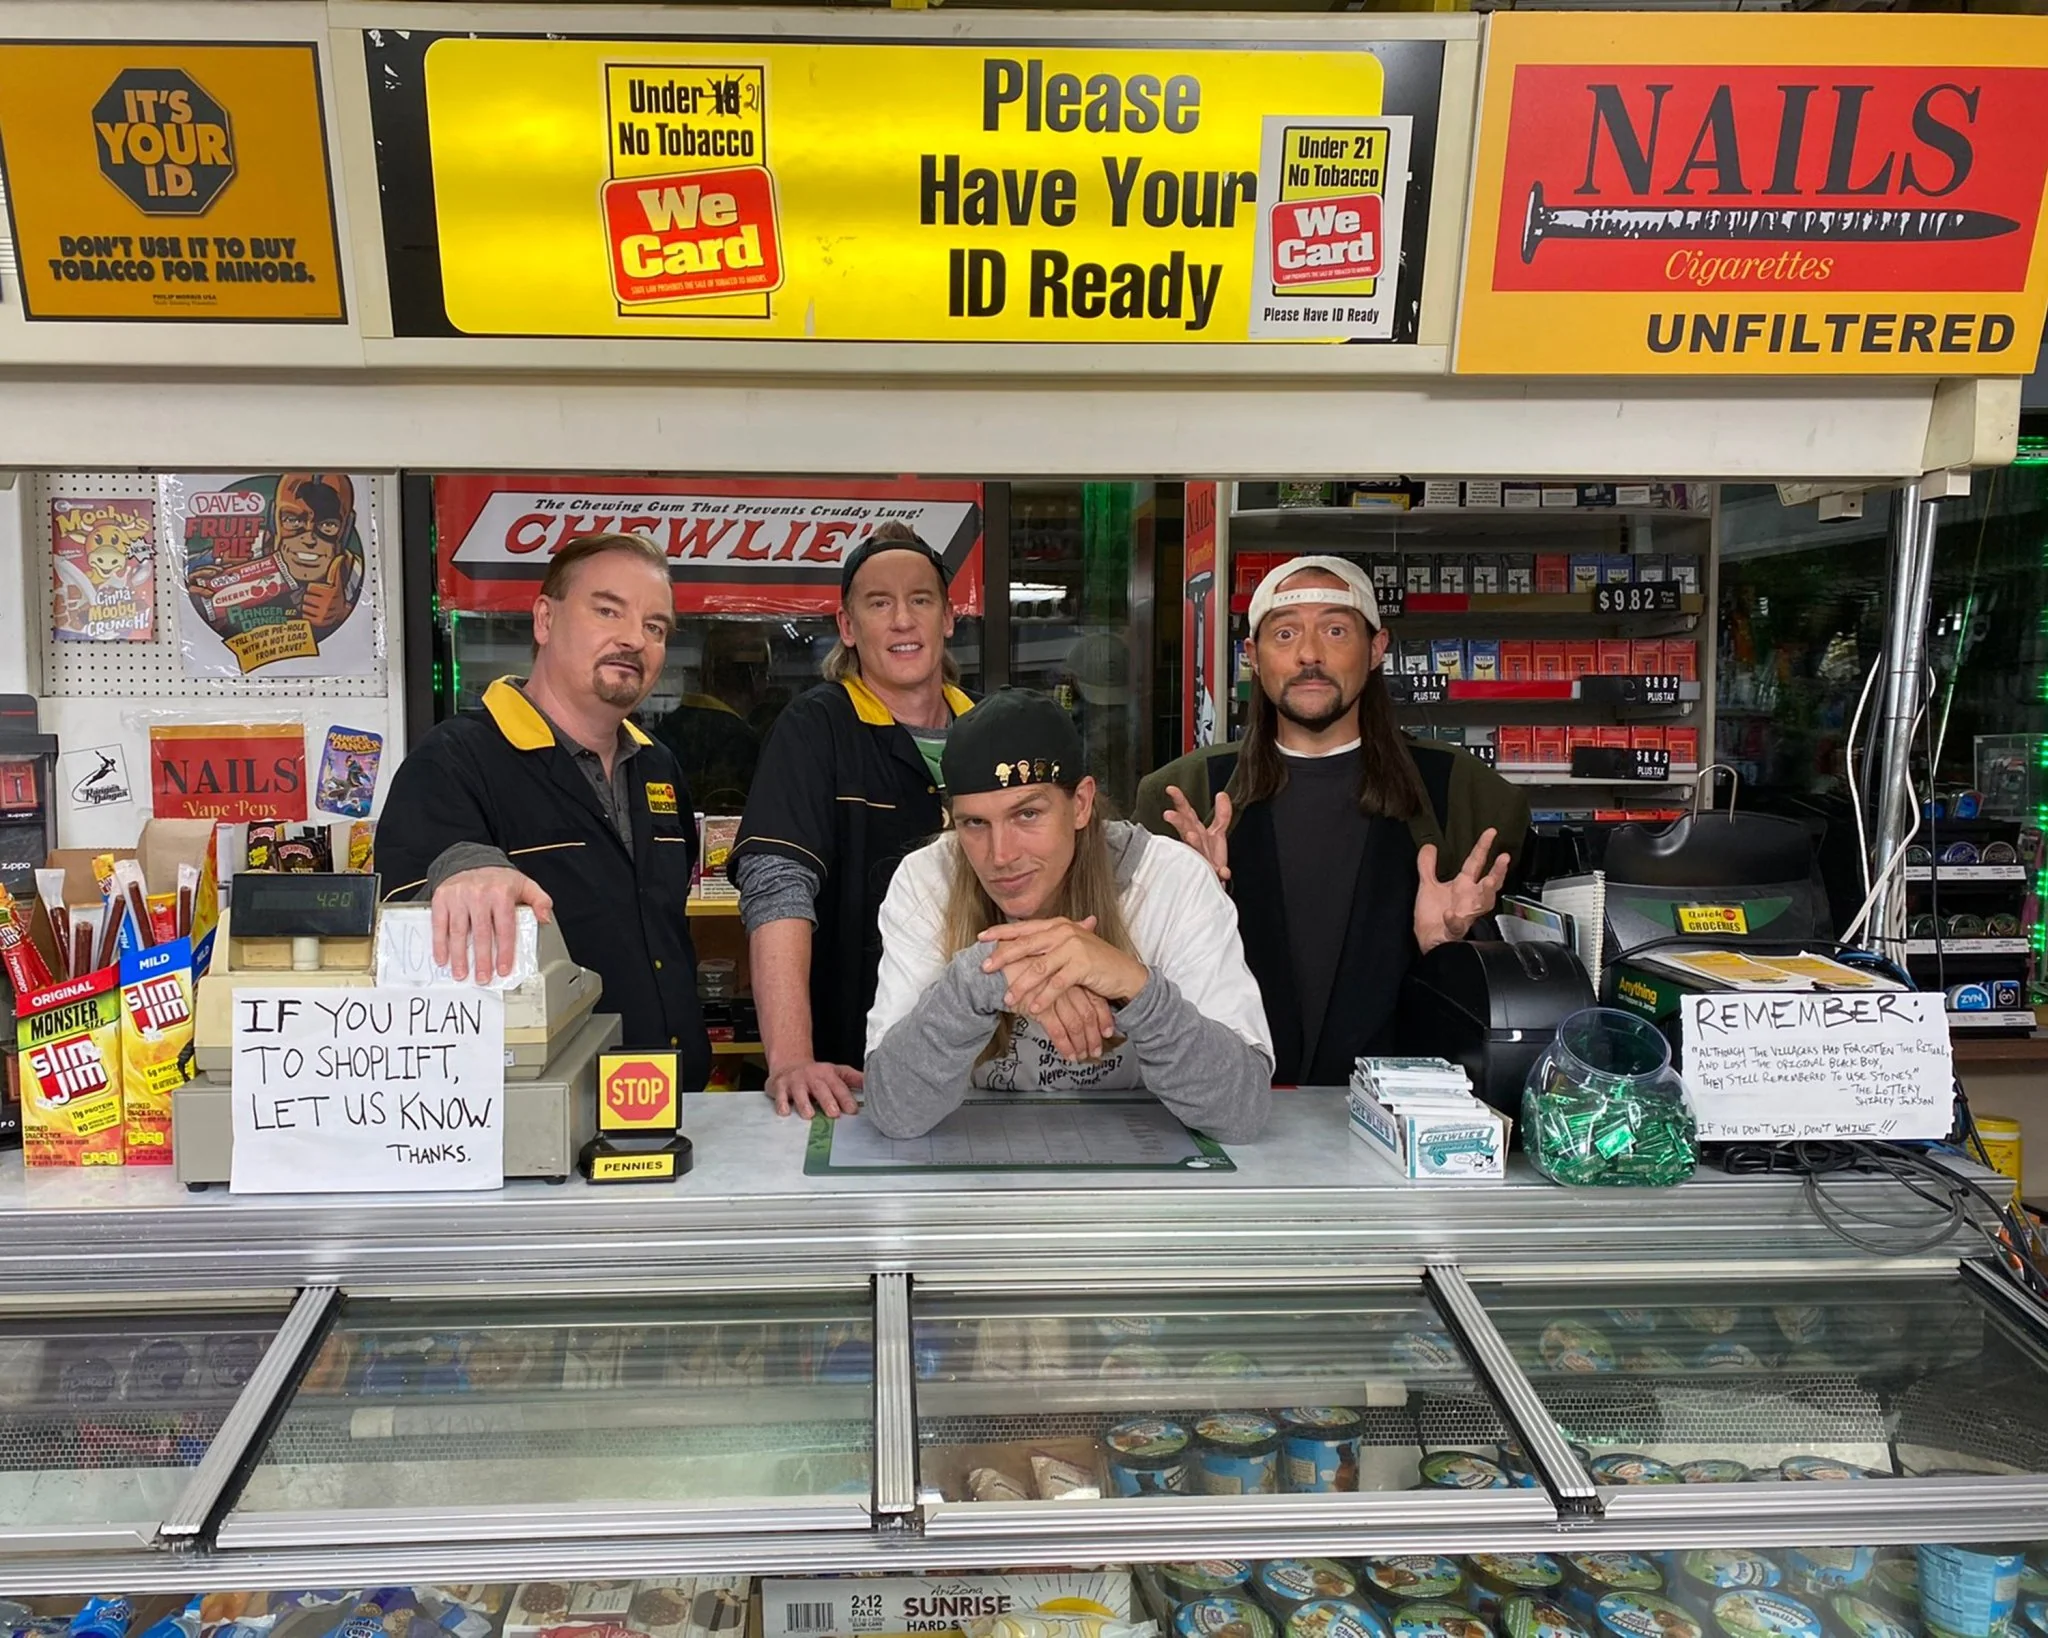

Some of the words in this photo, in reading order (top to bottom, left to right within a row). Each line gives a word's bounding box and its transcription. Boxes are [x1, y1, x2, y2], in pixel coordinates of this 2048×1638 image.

[124, 89, 193, 123] IT'S
[629, 79, 702, 114] Under
[983, 59, 1201, 132] Please
[95, 122, 232, 167] YOUR
[618, 122, 650, 156] No
[656, 123, 754, 157] Tobacco
[1299, 136, 1349, 159] Under
[1353, 137, 1374, 159] 21
[1574, 83, 1982, 197] NAILS
[145, 164, 197, 197] I.D.
[1288, 164, 1309, 186] No
[1314, 165, 1379, 187] Tobacco
[919, 154, 1077, 228] Have
[1101, 156, 1257, 229] Your
[637, 185, 738, 232] We
[1294, 205, 1361, 238] We
[59, 236, 133, 258] DON'T
[139, 237, 182, 258] USE
[188, 237, 209, 258] IT
[213, 237, 245, 258] TO
[250, 238, 296, 259] BUY
[620, 224, 764, 279] Card
[1278, 232, 1375, 270] Card
[49, 259, 155, 281] TOBACCO
[162, 260, 209, 282] FOR
[215, 262, 316, 283] MINORS.
[1665, 248, 1834, 287] Cigarettes
[948, 249, 1006, 318] ID
[1029, 249, 1223, 331] Ready
[1264, 308, 1299, 322] Please
[1303, 308, 1333, 322] Have
[1332, 308, 1344, 322] ID
[1347, 308, 1380, 324] Ready
[1646, 313, 2016, 353] UNFILTERED
[535, 499, 565, 510] The
[570, 500, 643, 513] Chewing
[648, 501, 685, 512] Gum
[690, 503, 728, 513] That
[733, 504, 805, 515] Prevents
[811, 506, 871, 518] Cruddy
[875, 508, 924, 519] Lung!
[184, 517, 265, 539] FRUIT
[213, 536, 256, 558] PIE
[215, 589, 249, 605] CHERRY
[88, 602, 137, 621] Mooby
[88, 607, 151, 637] CRUNCH!
[228, 606, 283, 625] RANGER
[242, 643, 260, 655] WITH
[262, 640, 268, 648] A
[269, 636, 285, 647] HOT
[287, 632, 307, 643] LOAD
[250, 629, 269, 642] YOUR
[271, 623, 306, 636] PIE-HOLE
[255, 649, 277, 662] FROM
[1413, 692, 1428, 701] PLUS
[1429, 692, 1440, 700] TAX
[1647, 692, 1663, 701] PLUS
[1663, 692, 1675, 700] TAX
[332, 739, 382, 752] DANGER
[159, 757, 299, 797] NAILS
[1637, 766, 1652, 775] PLUS
[1654, 767, 1664, 776] TAX
[183, 800, 230, 819] Vape
[234, 800, 278, 819] Pens
[1688, 910, 1721, 918] Quick
[1688, 922, 1740, 932] GROCERIES
[139, 953, 170, 970] MILD
[32, 979, 94, 1007] ORIGINAL
[1619, 977, 1657, 1005] Anything
[1961, 994, 1982, 1003] ZYN
[31, 1000, 98, 1041] MONSTER
[84, 1018, 106, 1030] SIZE
[241, 999, 302, 1033] IF
[314, 997, 392, 1038] YOU
[409, 997, 481, 1035] PLAN
[1822, 1045, 1839, 1055] HAD
[1843, 1042, 1894, 1055] FORGOTTEN
[241, 1046, 304, 1084] TO
[316, 1044, 459, 1085] SHOPLIFT,
[1697, 1060, 1719, 1071] AND
[1723, 1060, 1747, 1069] LOST
[1751, 1059, 1770, 1069] THE
[1777, 1058, 1825, 1069] ORIGINAL
[1699, 1073, 1723, 1090] THEY
[1726, 1074, 1759, 1086] STILL
[1762, 1072, 1826, 1083] REMEMBERED
[1846, 1071, 1866, 1081] USE
[1851, 1084, 1872, 1095] THE
[1875, 1084, 1920, 1098] LOTTERY
[611, 1078, 664, 1106] STOP
[72, 1110, 84, 1120] 11g
[84, 1101, 114, 1114] PROTEIN
[252, 1094, 329, 1130] LET
[345, 1091, 386, 1125] US
[400, 1092, 492, 1131] KNOW.
[78, 1123, 88, 1133] NO
[1426, 1130, 1484, 1142] CHEWLIE'S
[1699, 1123, 1714, 1134] IF
[1721, 1124, 1738, 1134] YOU
[1835, 1123, 1877, 1134] WHINE
[603, 1160, 663, 1172] PENNIES
[930, 1585, 984, 1596] AriZona
[852, 1609, 882, 1617] PACK
[903, 1596, 1011, 1617] SUNRISE
[907, 1620, 947, 1632] HARD
